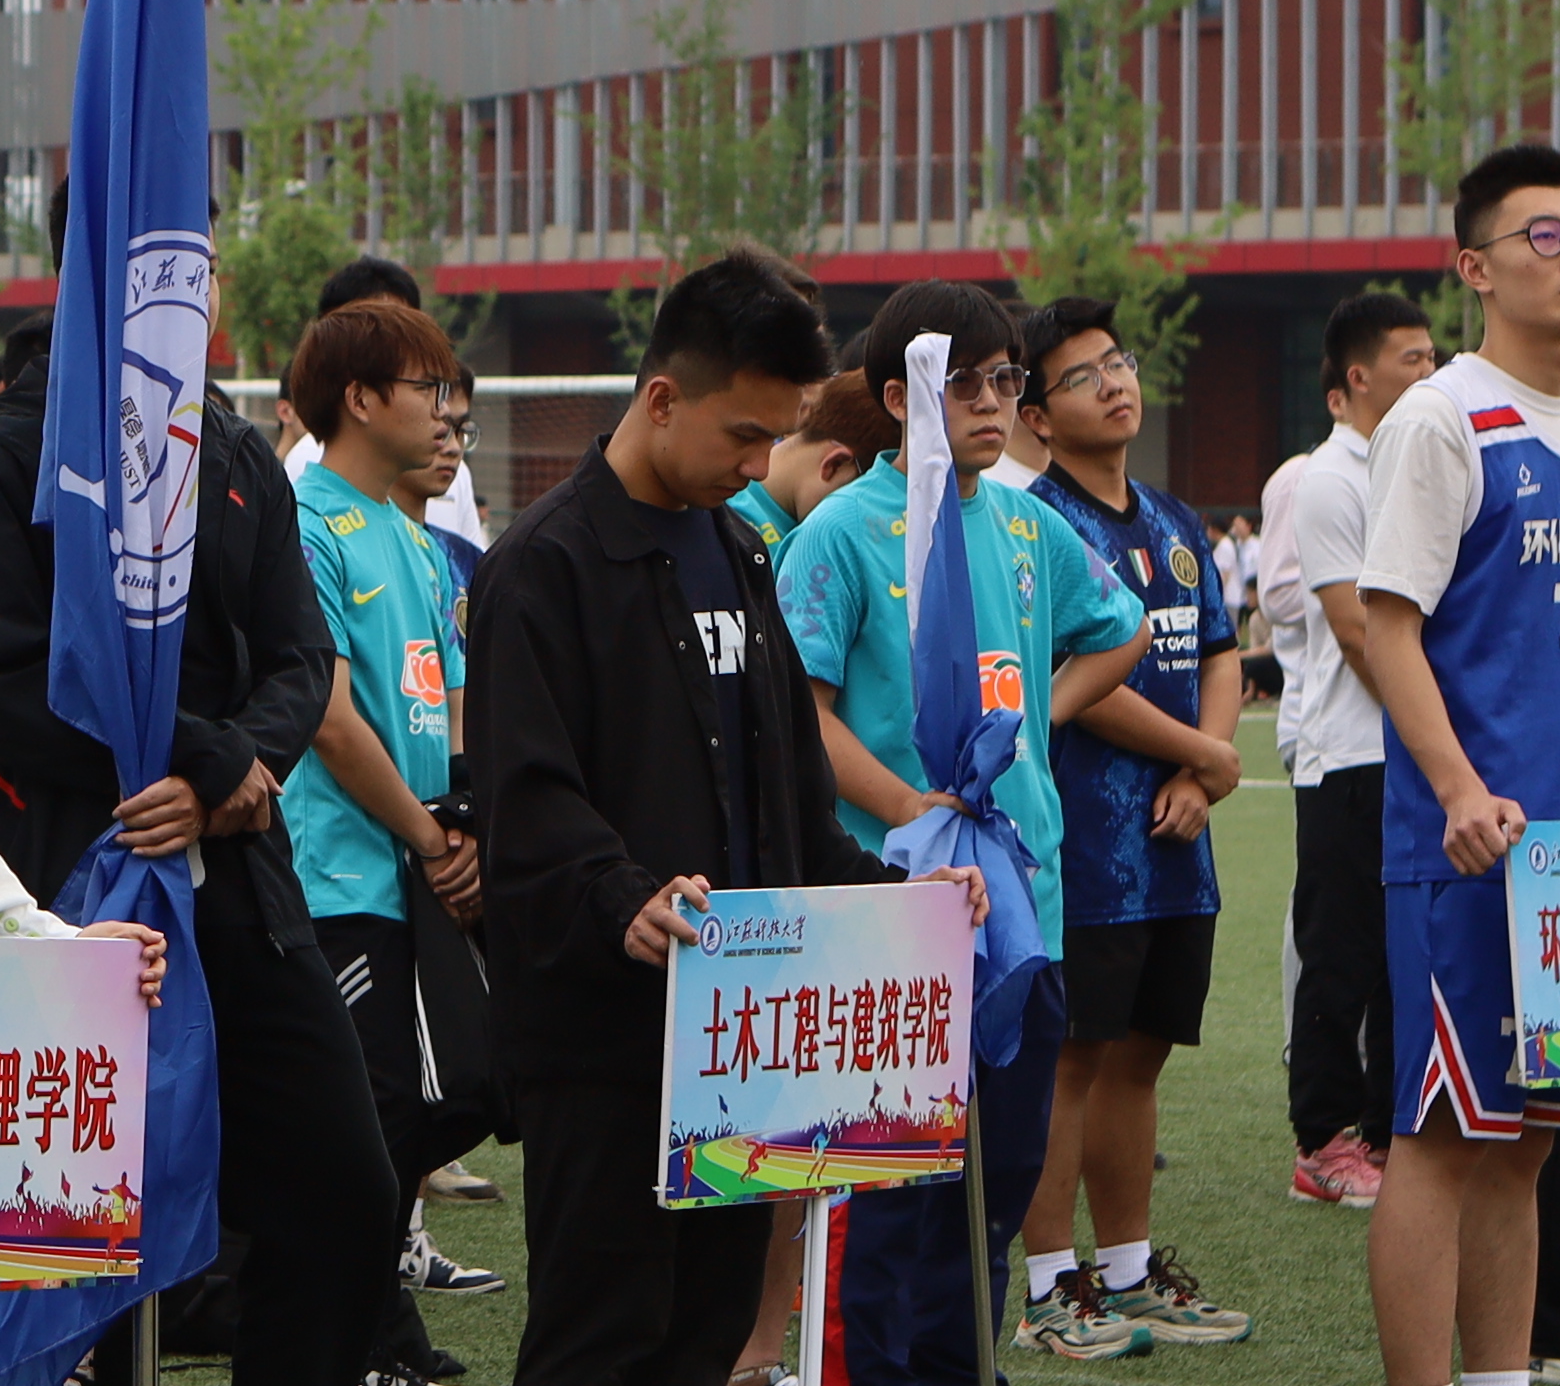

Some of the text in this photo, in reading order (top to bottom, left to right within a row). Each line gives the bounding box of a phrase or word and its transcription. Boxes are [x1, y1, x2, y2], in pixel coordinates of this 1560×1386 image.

[796, 564, 832, 639] vivo
[699, 972, 953, 1083] 土木工程与建筑学院
